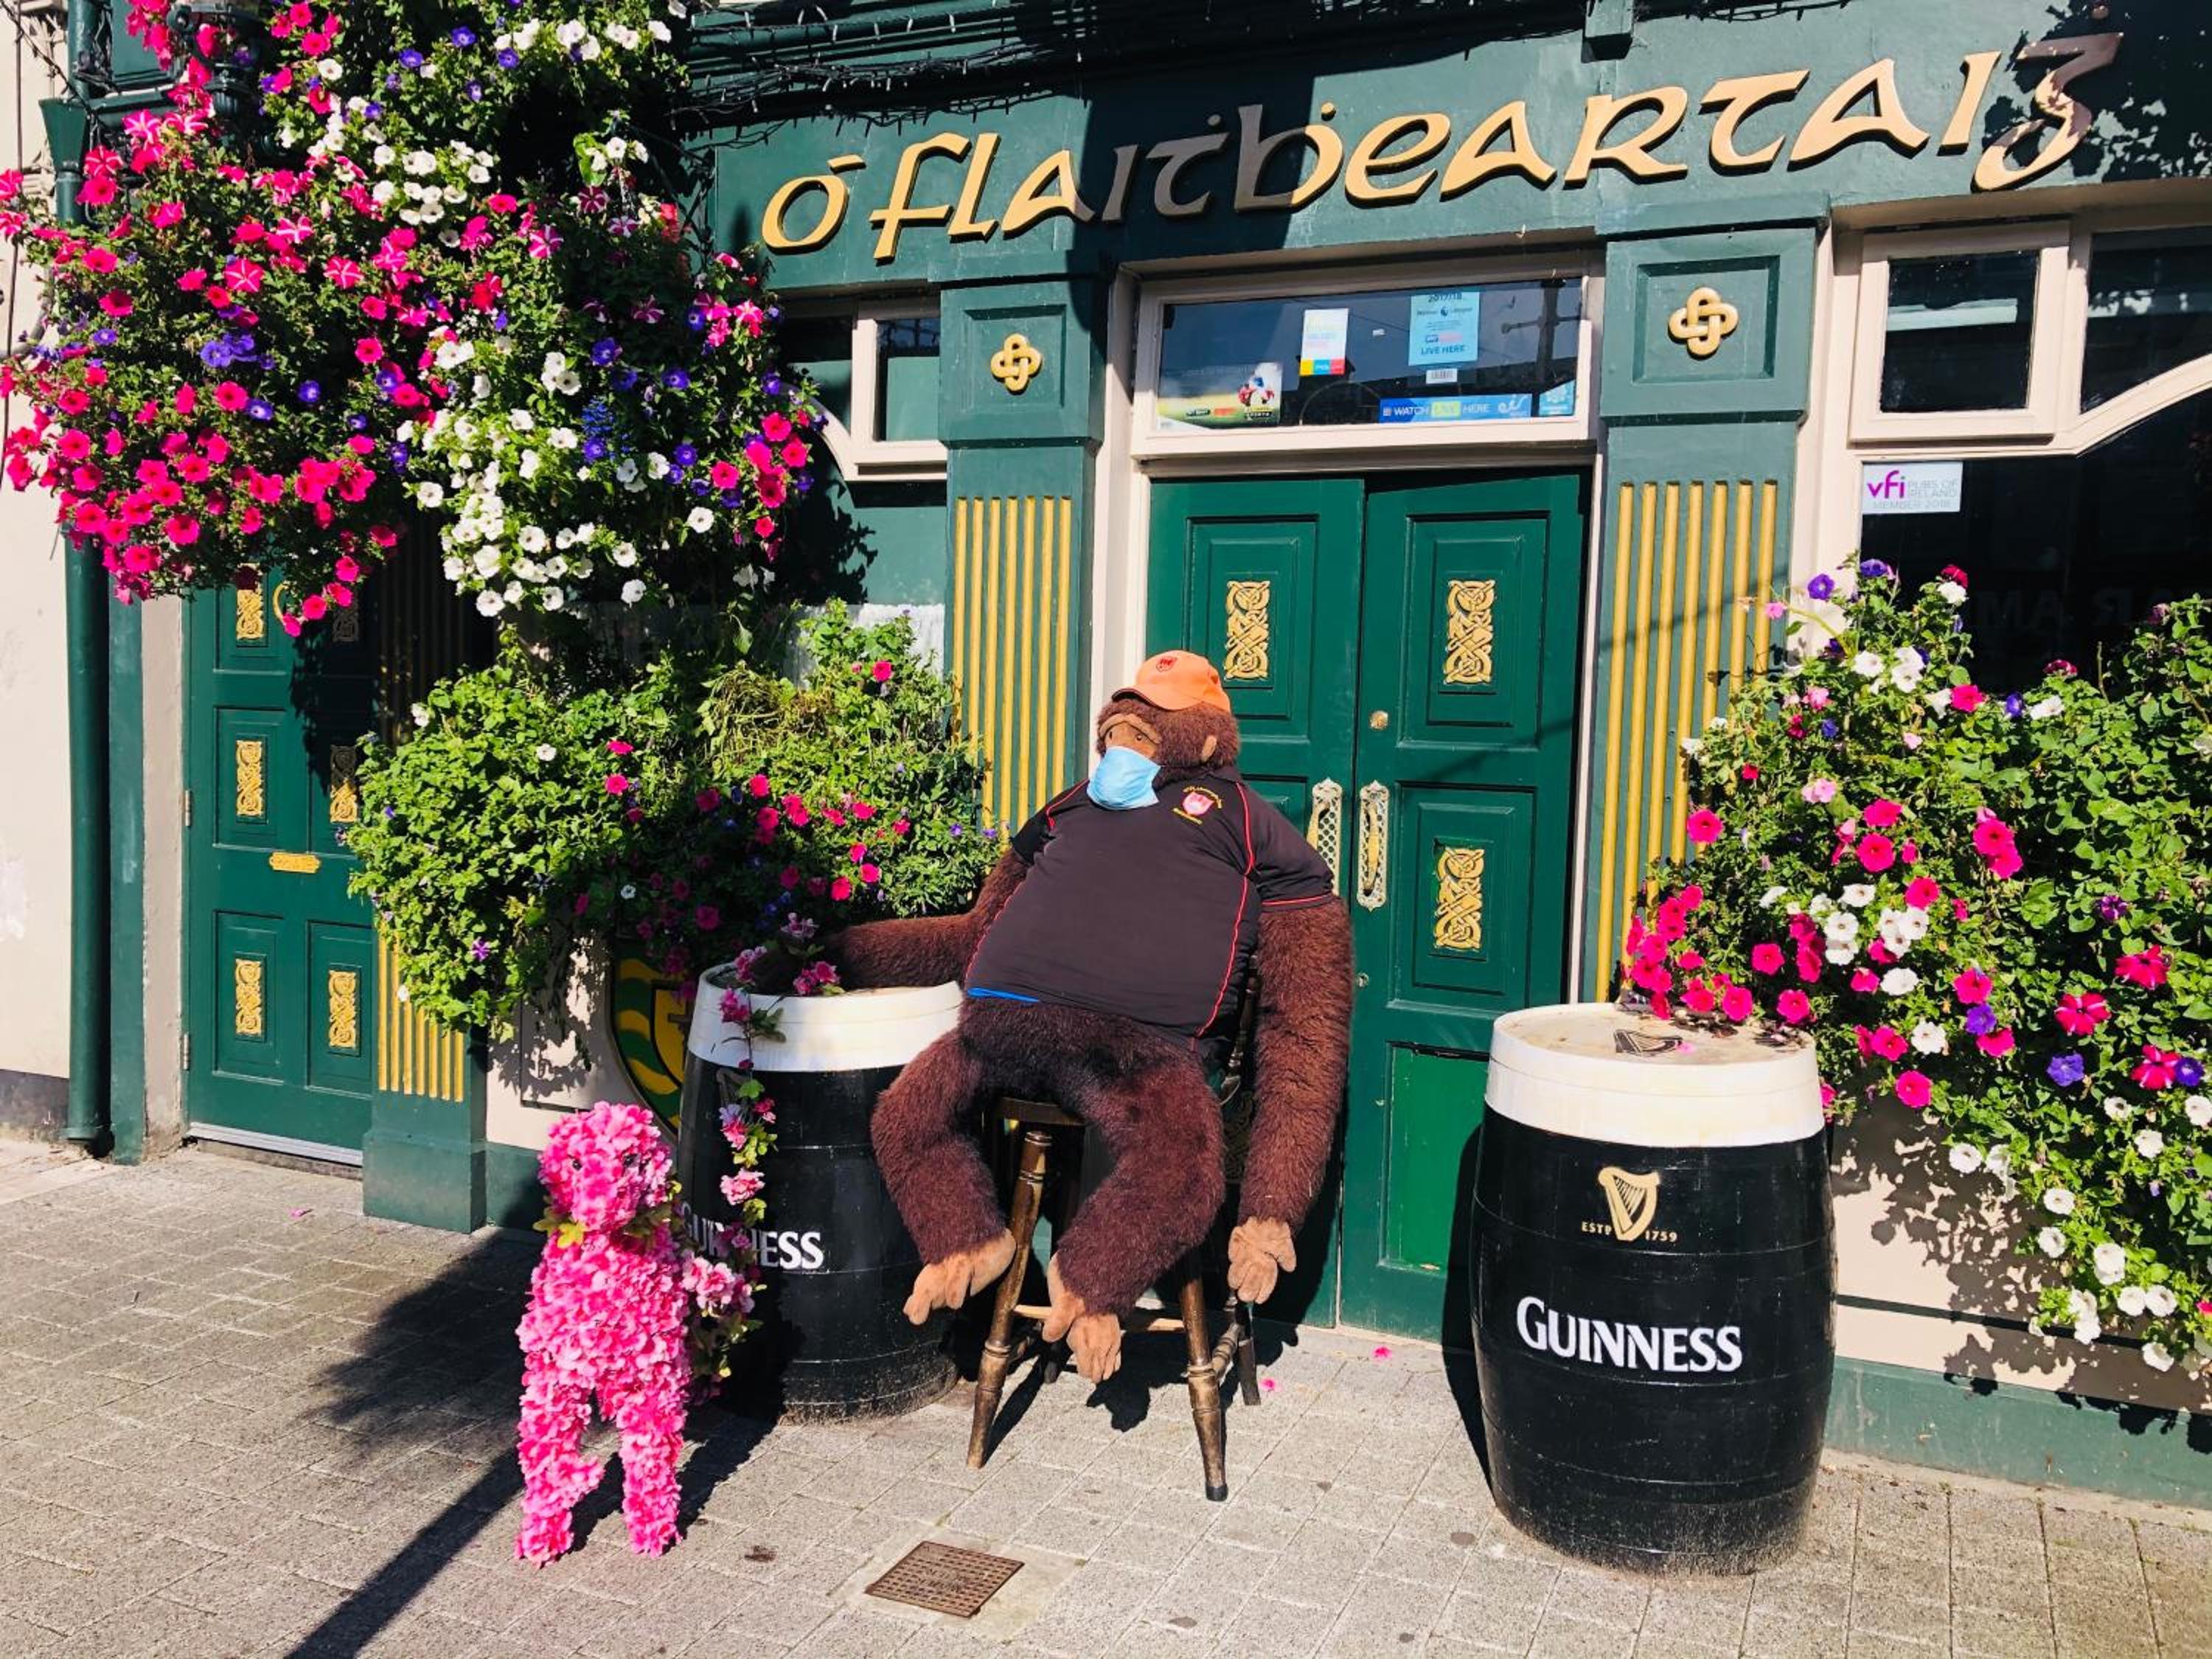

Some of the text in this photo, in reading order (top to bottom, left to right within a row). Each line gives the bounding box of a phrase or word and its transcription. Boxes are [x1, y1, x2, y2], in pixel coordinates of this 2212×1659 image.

[1394, 406, 1428, 416] WATCH
[1867, 470, 1905, 499] vfi
[1645, 1230, 1677, 1242] 1759
[1516, 1295, 1743, 1372] GUINNESS
